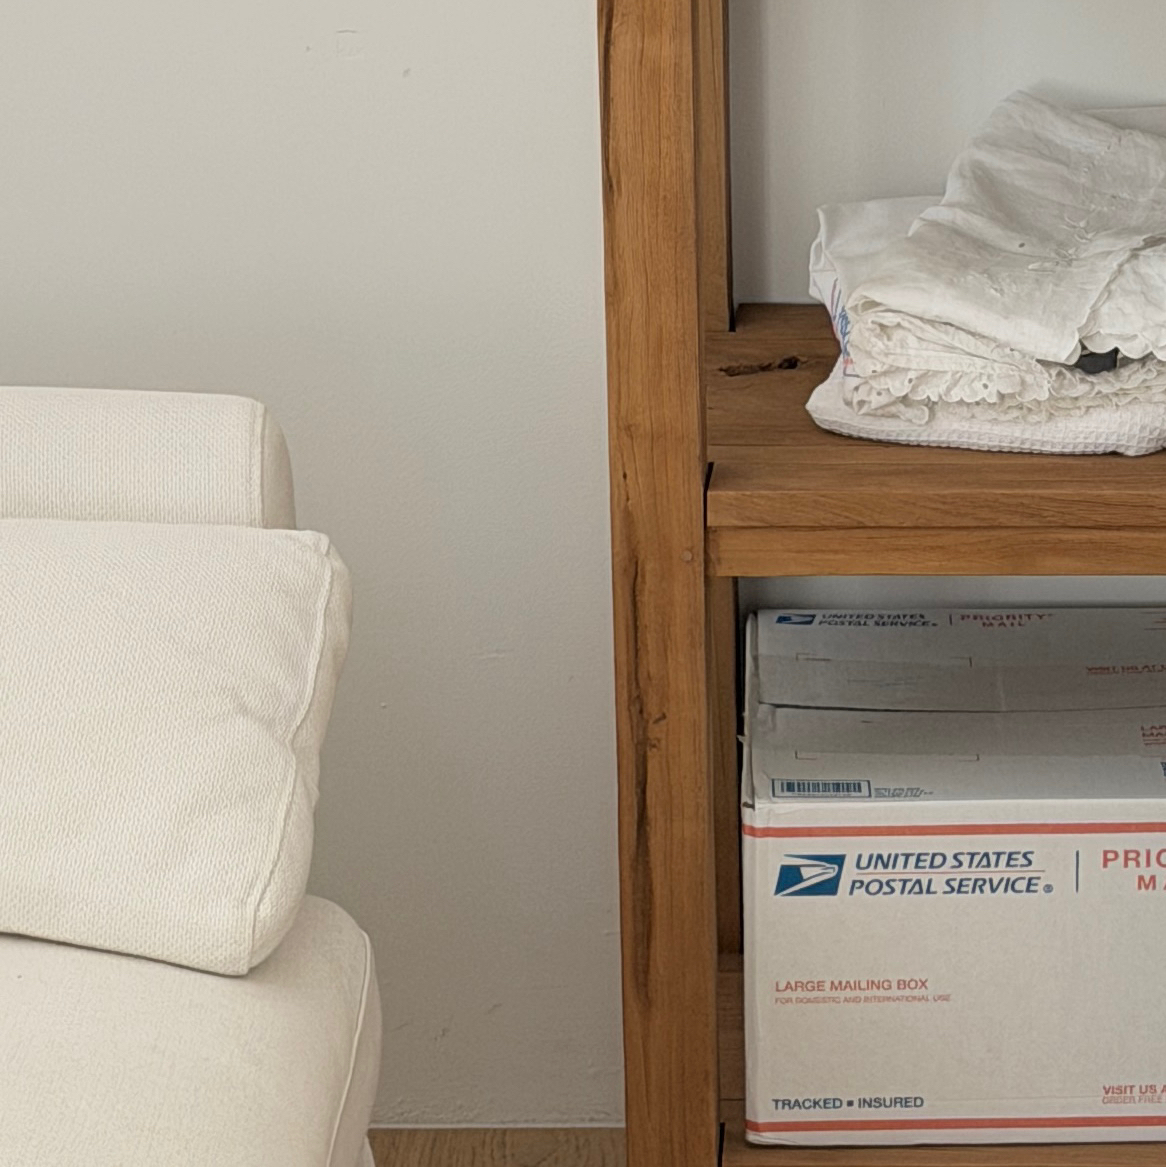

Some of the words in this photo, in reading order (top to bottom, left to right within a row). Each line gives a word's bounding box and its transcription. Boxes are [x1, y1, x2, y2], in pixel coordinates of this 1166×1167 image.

[856, 852, 947, 870] UNITED
[950, 851, 1035, 869] STATES
[849, 878, 938, 896] POSTAL
[775, 980, 826, 992] LARGE
[830, 979, 892, 991] MAILING
[896, 978, 929, 991] BOX
[1102, 1084, 1136, 1095] VISIT
[1139, 1084, 1157, 1094] US
[772, 1098, 843, 1110] TRACKED
[858, 1096, 924, 1109] INSURED
